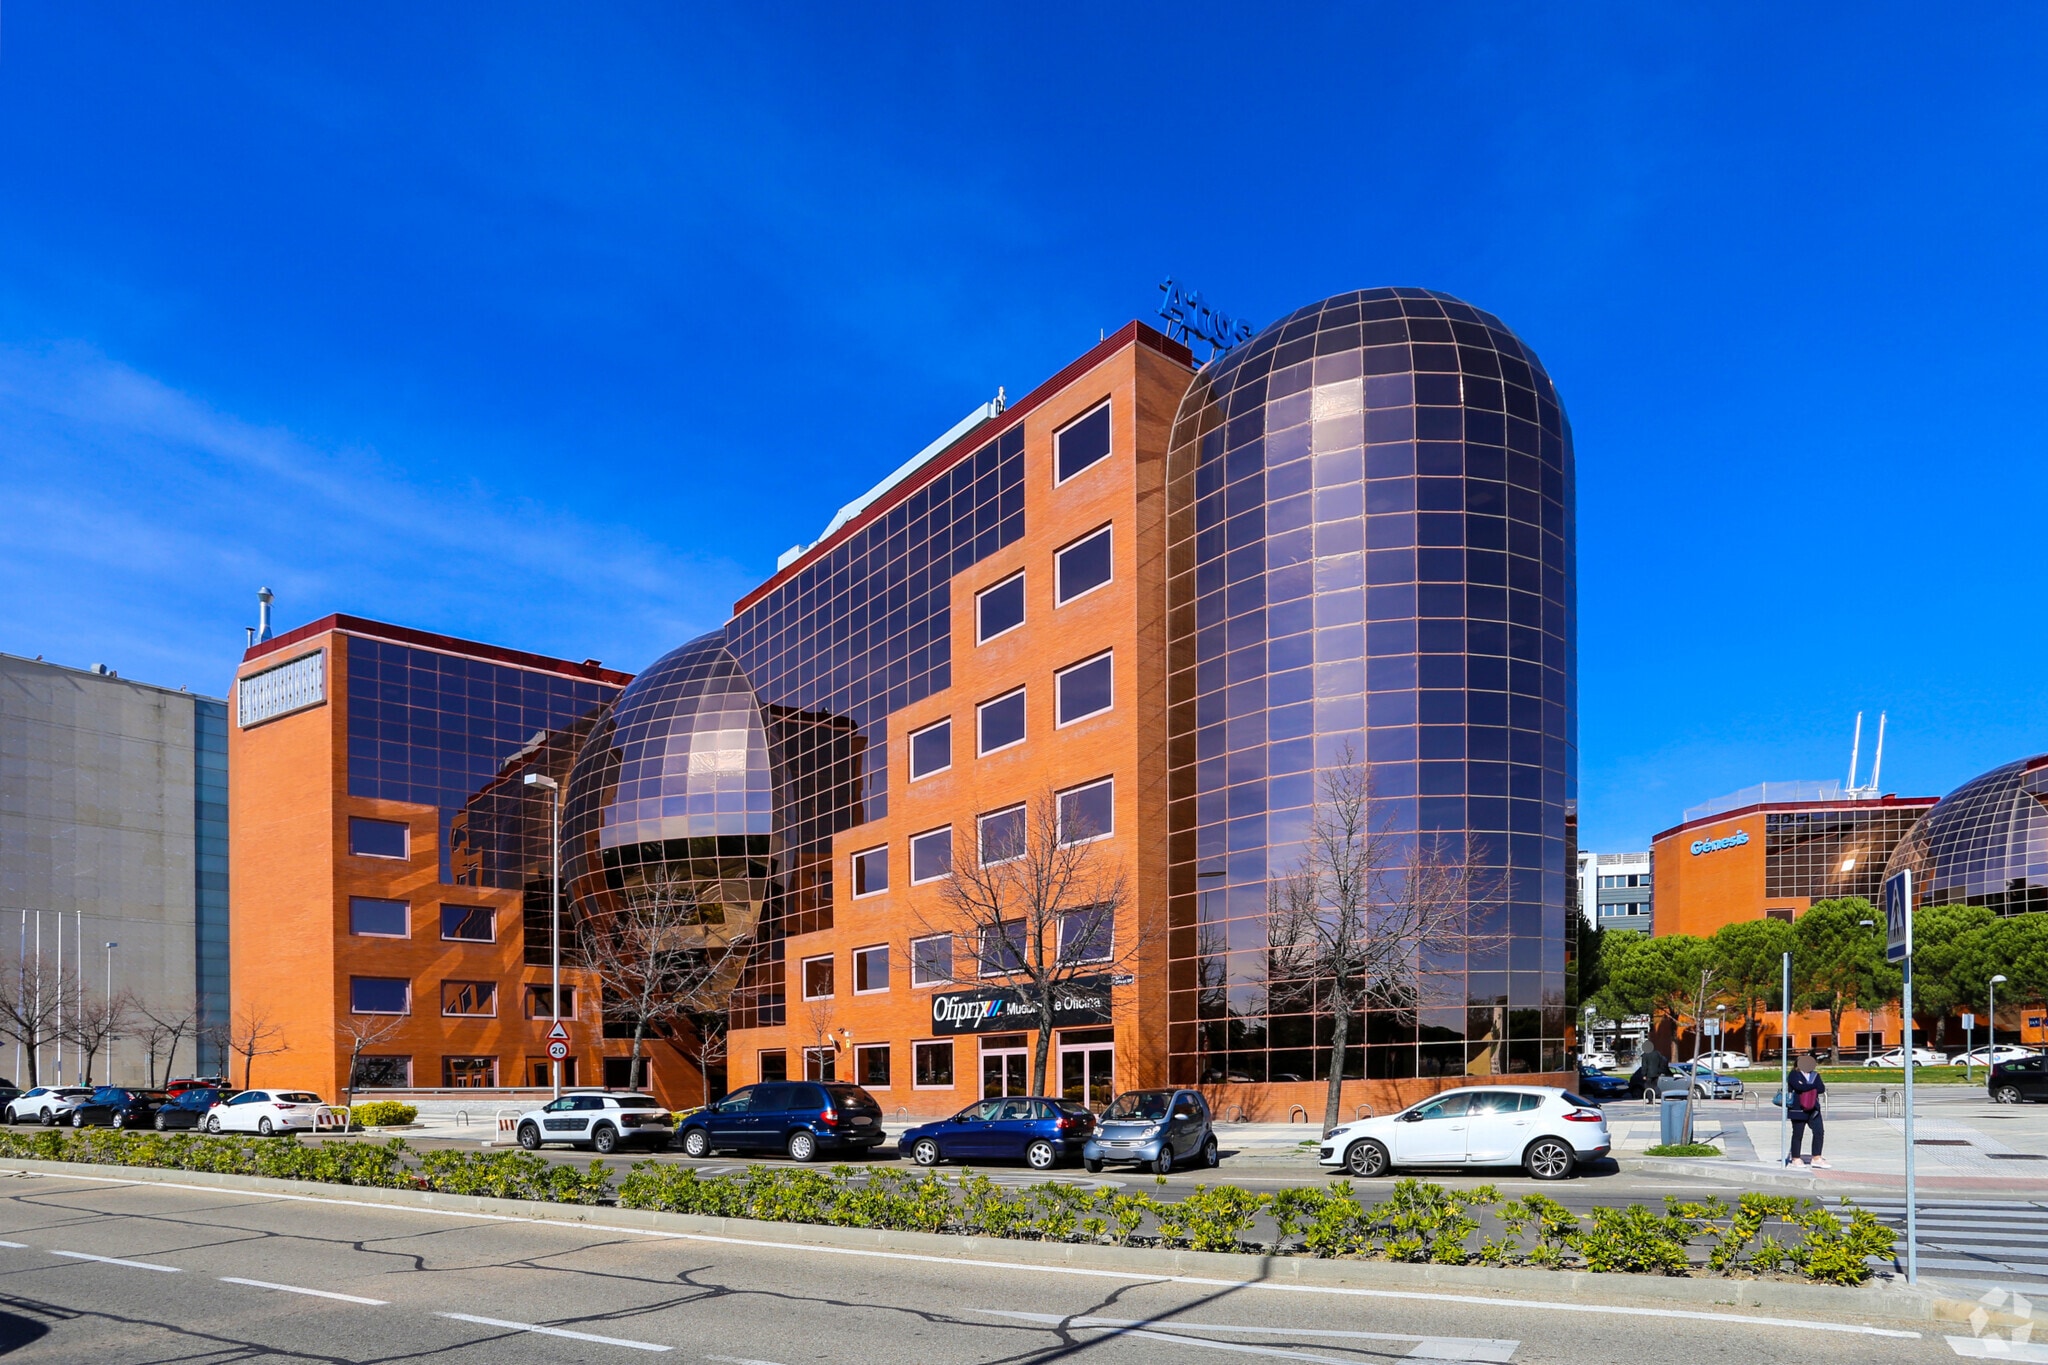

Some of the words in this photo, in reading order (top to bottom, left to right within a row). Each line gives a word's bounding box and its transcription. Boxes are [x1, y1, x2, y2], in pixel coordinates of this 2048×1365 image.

[1690, 829, 1750, 856] Génesis
[933, 994, 990, 1028] Ofiprix
[551, 1046, 565, 1055] 20
